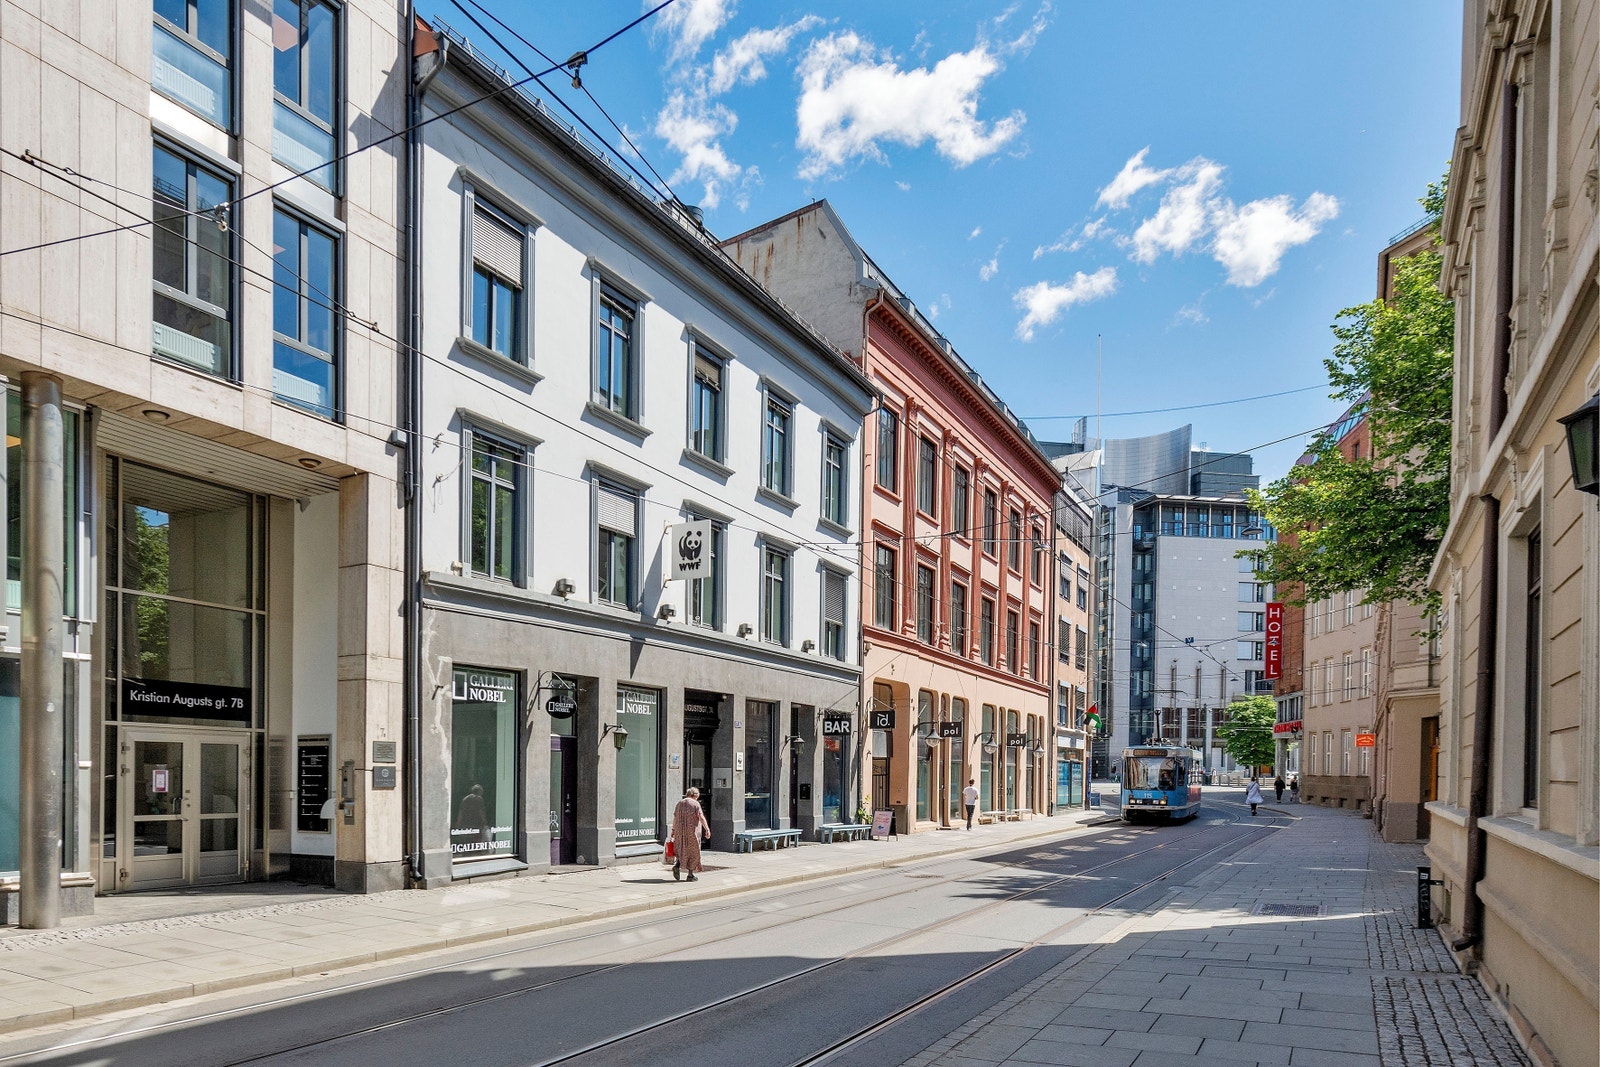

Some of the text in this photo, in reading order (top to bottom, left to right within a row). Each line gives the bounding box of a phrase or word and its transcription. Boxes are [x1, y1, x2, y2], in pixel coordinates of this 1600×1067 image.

[679, 562, 701, 572] WWF
[1268, 608, 1280, 675] HOTEL
[470, 674, 514, 690] GALLERI
[130, 690, 244, 710] Kristian Augusts gt. 7B
[469, 687, 506, 702] NOBEL
[626, 692, 656, 704] GALLERI
[626, 702, 652, 715] NOBEL
[824, 721, 850, 733] BAR
[944, 727, 958, 736] pol
[618, 828, 655, 838] GALLERI NOBEL
[457, 840, 512, 852] GALLERI NOBEL
